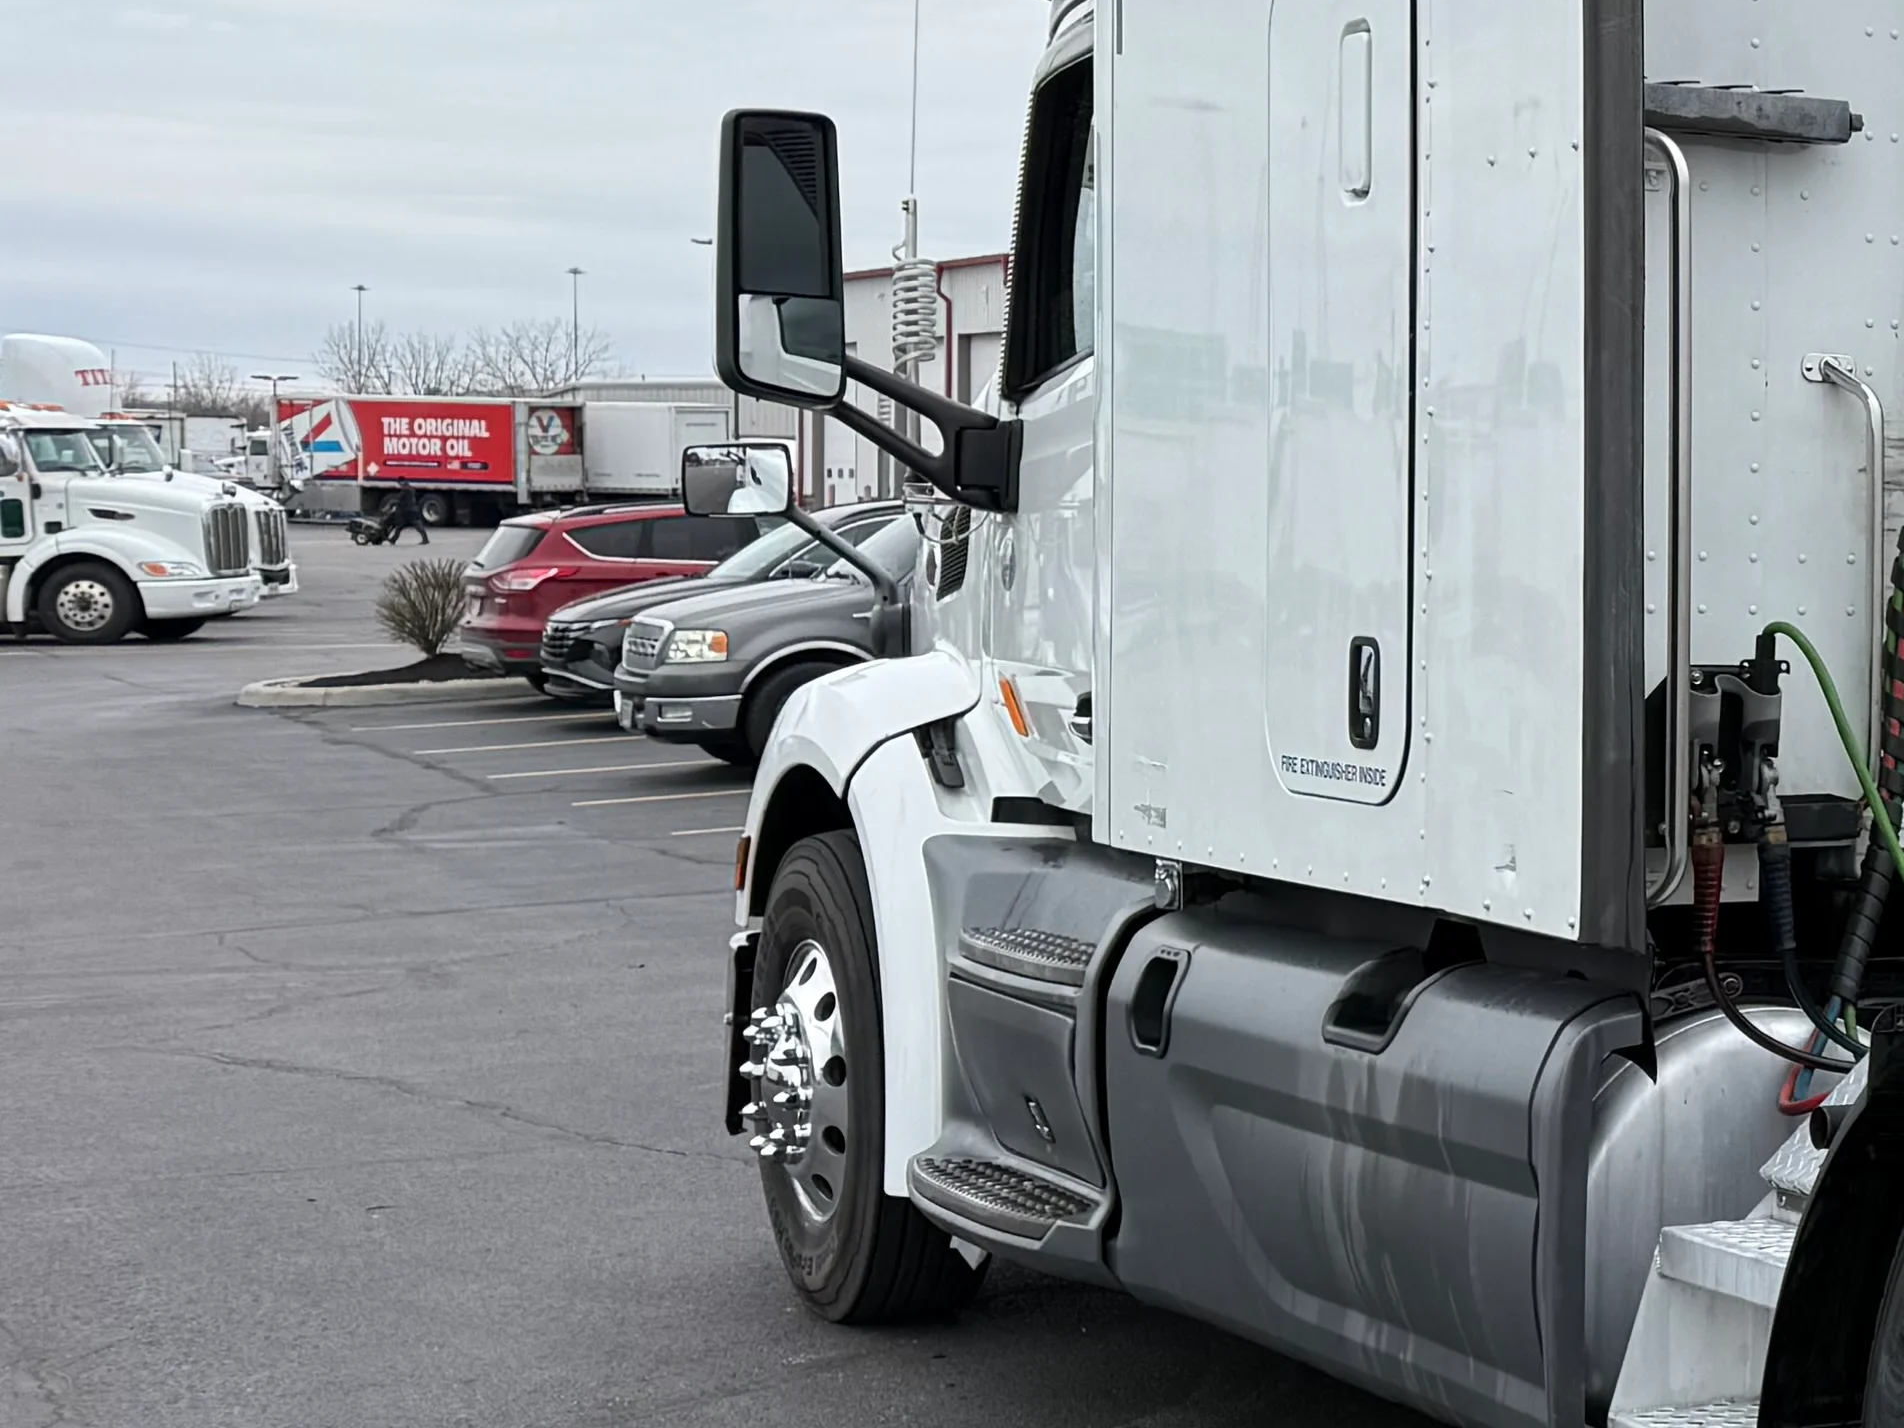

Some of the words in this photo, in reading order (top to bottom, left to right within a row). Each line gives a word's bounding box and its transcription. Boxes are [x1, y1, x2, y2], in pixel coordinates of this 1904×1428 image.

[381, 417, 409, 436] THE
[413, 418, 490, 438] ORIGINAL
[384, 437, 441, 456] MOTOR
[446, 438, 472, 457] OIL
[1281, 755, 1298, 773] FIRE
[1300, 758, 1358, 782] EXTINGUISHER
[1359, 766, 1387, 787] INSIDE
